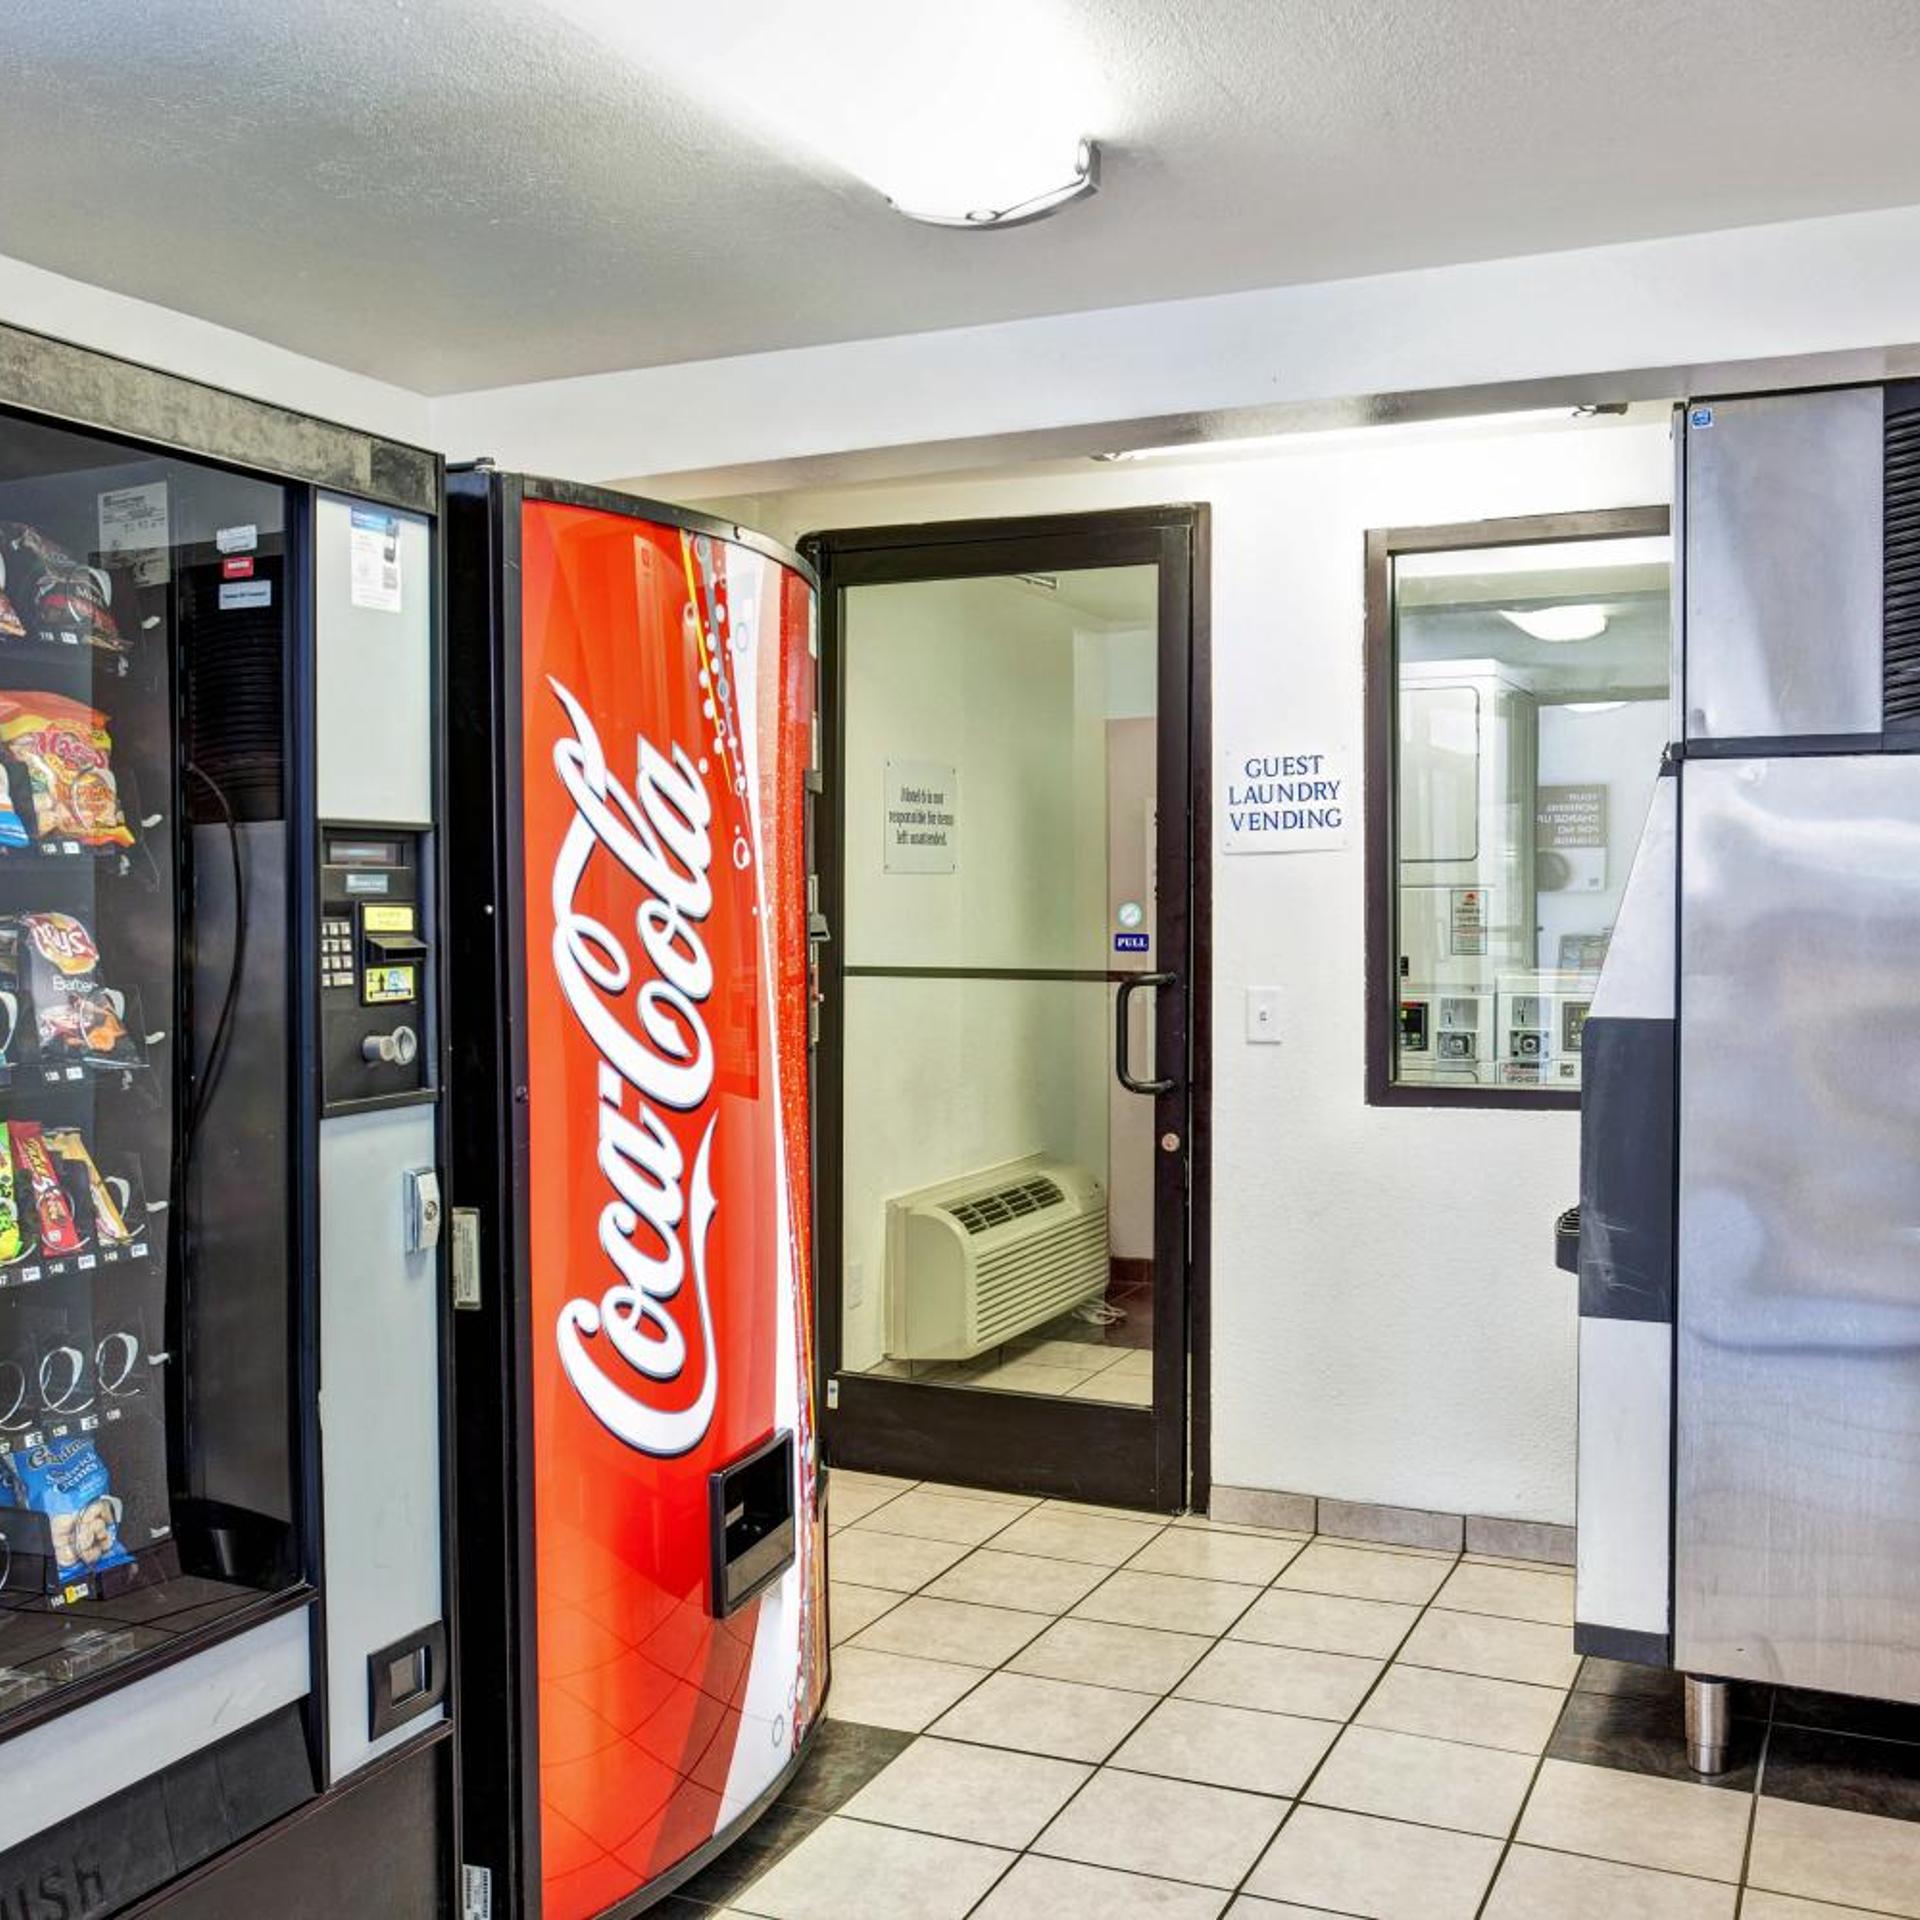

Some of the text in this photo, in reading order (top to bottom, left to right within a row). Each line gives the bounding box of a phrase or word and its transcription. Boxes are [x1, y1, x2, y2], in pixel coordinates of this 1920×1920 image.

[1245, 754, 1324, 778] GUEST
[1228, 780, 1340, 805] LAUNDRY
[1228, 808, 1342, 831] VENDING
[1117, 937, 1148, 948] PULL
[546, 674, 719, 1460] Coca-Cola
